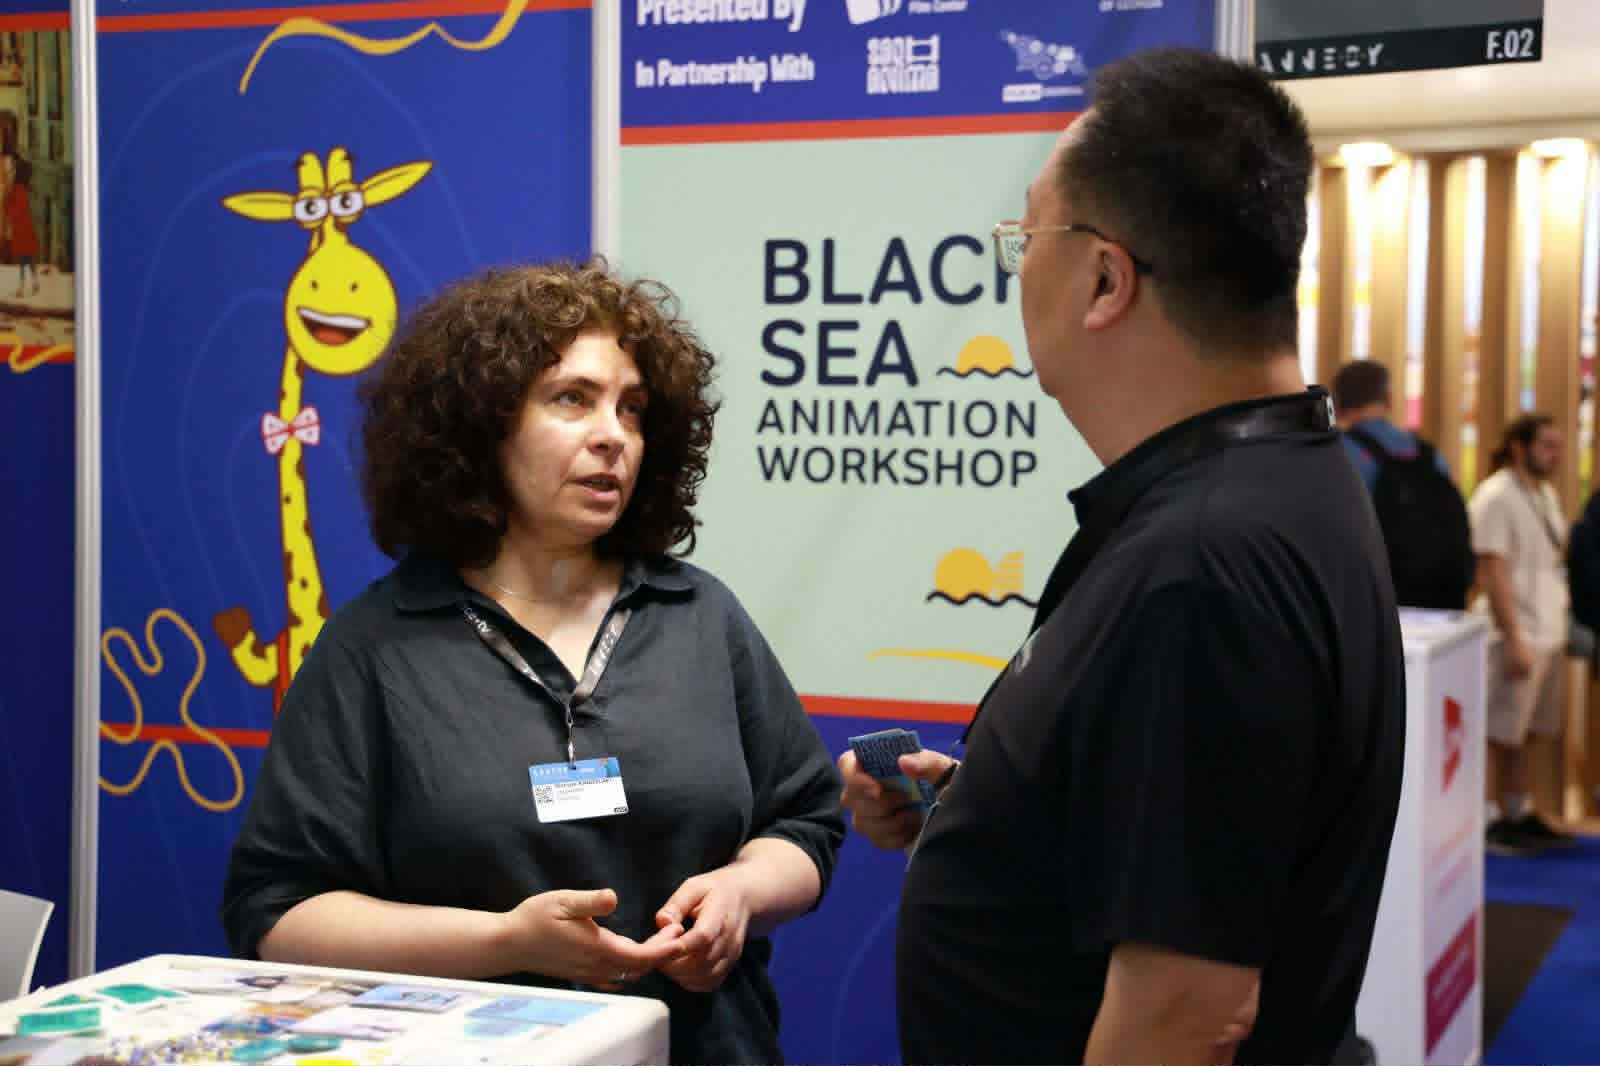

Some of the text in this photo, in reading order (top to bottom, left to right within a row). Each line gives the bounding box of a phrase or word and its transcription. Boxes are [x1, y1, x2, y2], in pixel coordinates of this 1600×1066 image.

[636, 0, 808, 32] Presented by
[1486, 28, 1535, 60] F.02
[635, 52, 816, 93] In Partnership With
[760, 318, 919, 388] SEA
[757, 397, 1037, 438] ANIMATION
[757, 444, 1038, 488] WORKSHOP
